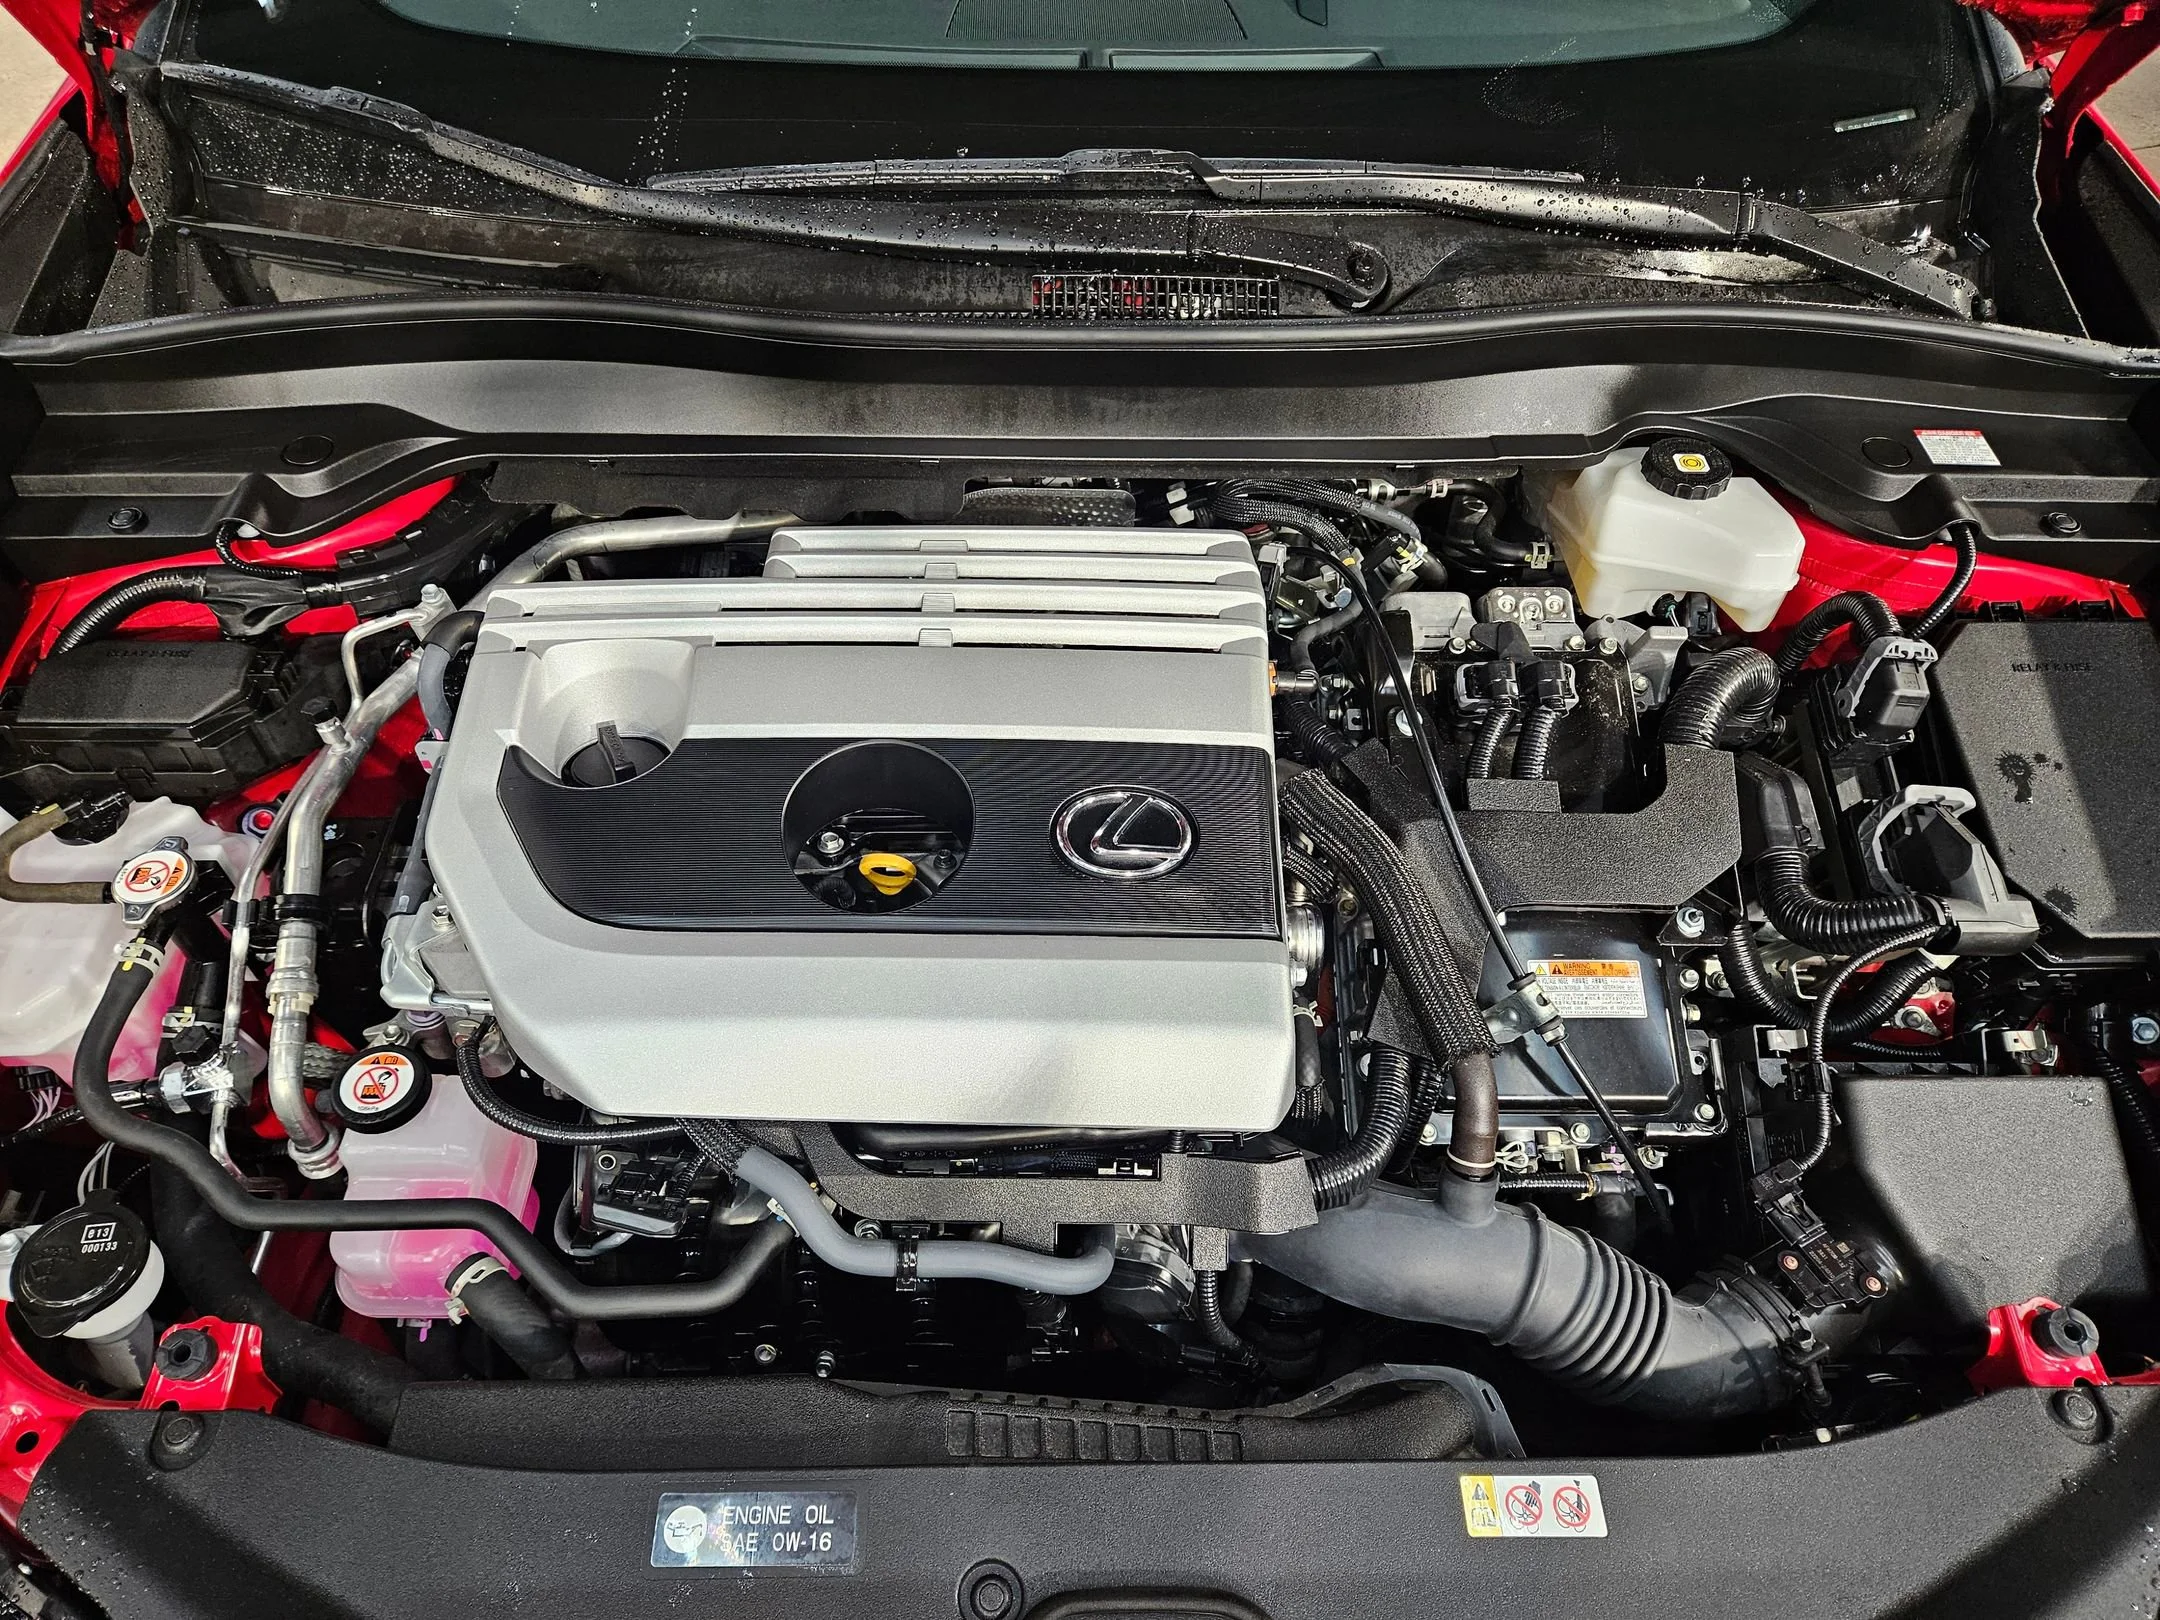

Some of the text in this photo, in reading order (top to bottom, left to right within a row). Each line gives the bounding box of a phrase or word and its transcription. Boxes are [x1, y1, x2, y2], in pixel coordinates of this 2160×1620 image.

[87, 1227, 110, 1239] e13
[81, 1241, 118, 1254] 000133
[722, 1505, 834, 1525] ENGINE OIL
[720, 1532, 832, 1552] SAE 0W-16
